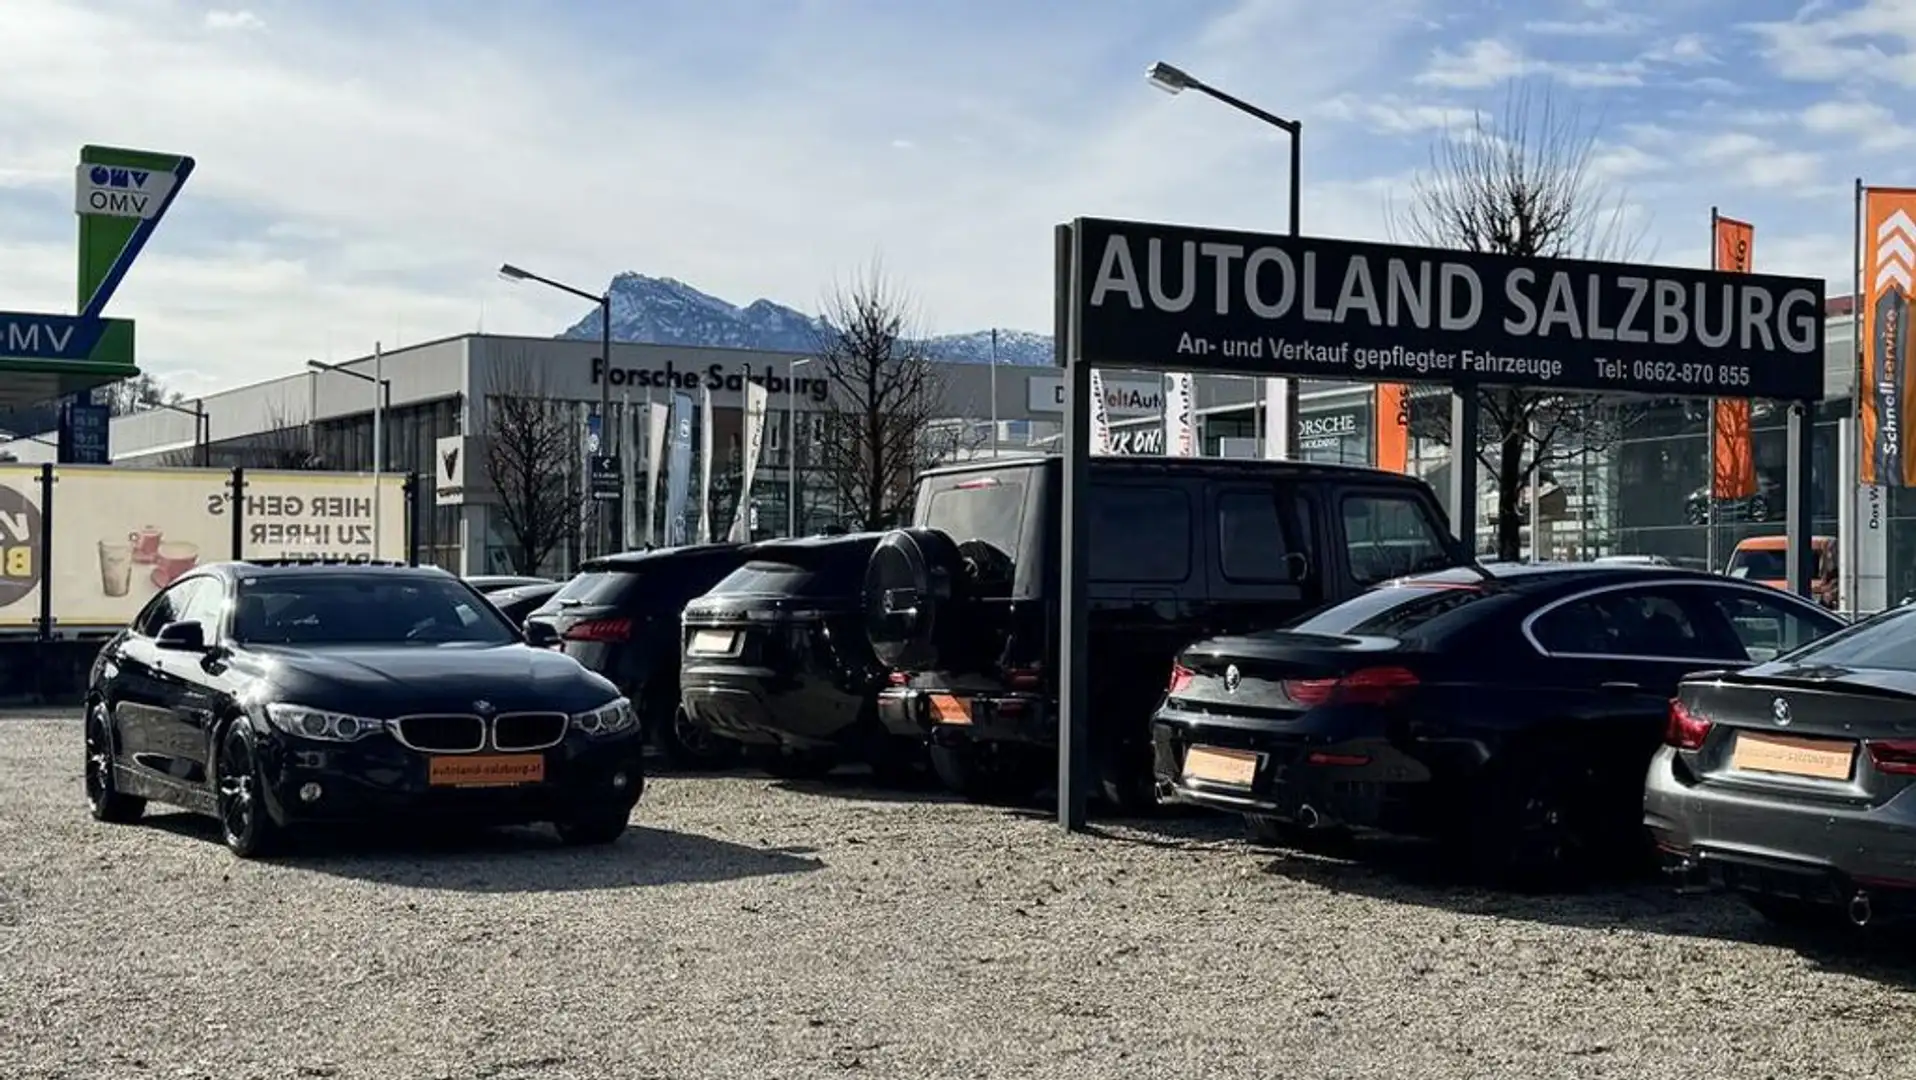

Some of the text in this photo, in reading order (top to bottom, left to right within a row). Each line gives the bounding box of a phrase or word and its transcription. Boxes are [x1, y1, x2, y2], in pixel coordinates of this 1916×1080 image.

[89, 191, 149, 212] OMV
[1090, 234, 1817, 353] AUTOLAND SALZBURG
[0, 322, 75, 352] MV
[590, 358, 829, 400] Porsche Saburg
[1177, 331, 1750, 386] An- und Verkauf gepflegter Fahrzeuge Tel: 0662-870 855
